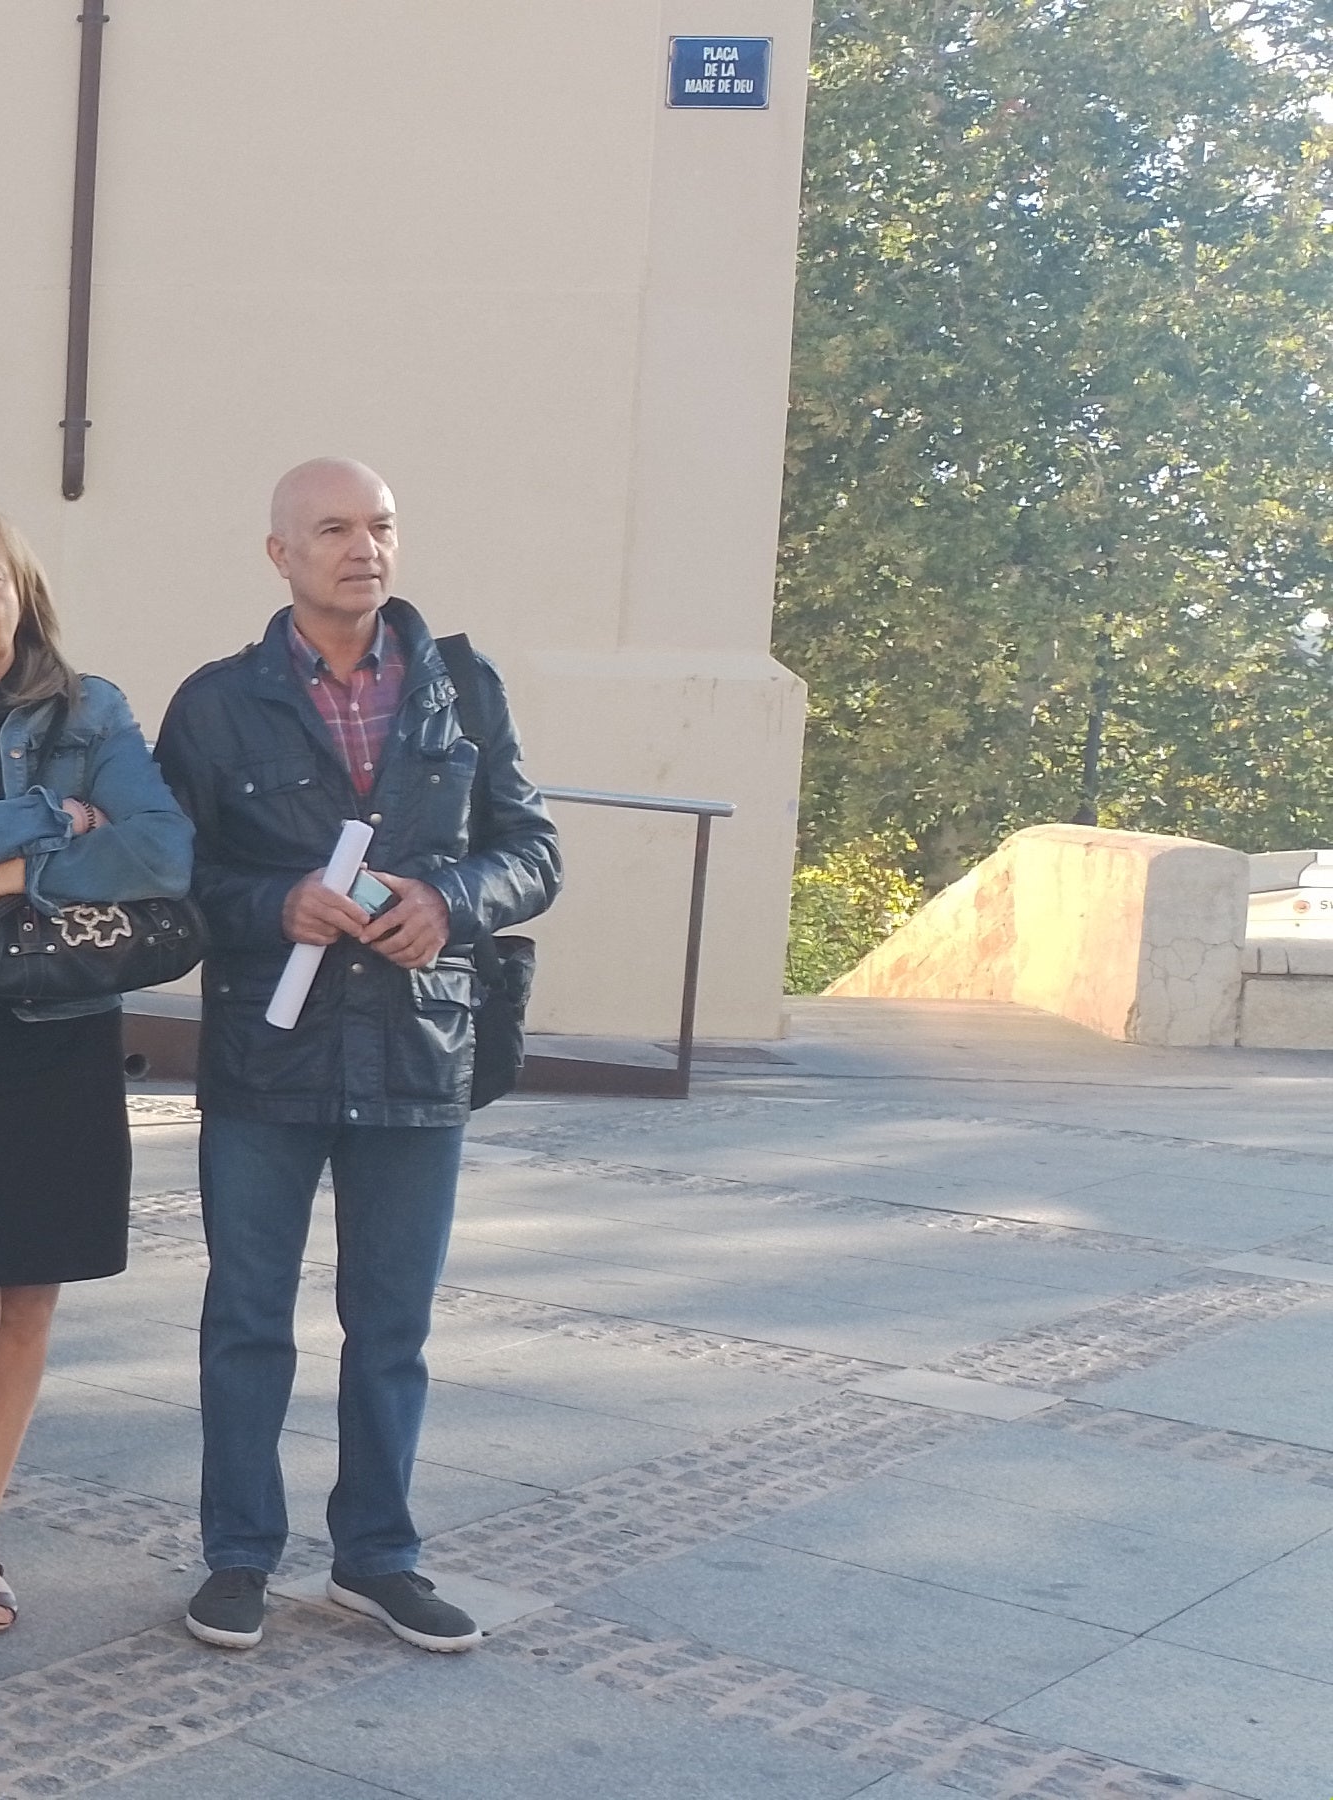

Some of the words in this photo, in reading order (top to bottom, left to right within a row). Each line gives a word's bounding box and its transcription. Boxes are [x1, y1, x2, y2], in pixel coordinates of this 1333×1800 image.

[704, 63, 718, 77] DE
[721, 63, 735, 77] LA
[685, 79, 715, 93] MARE
[717, 79, 731, 94] DE
[733, 79, 753, 94] DEU
